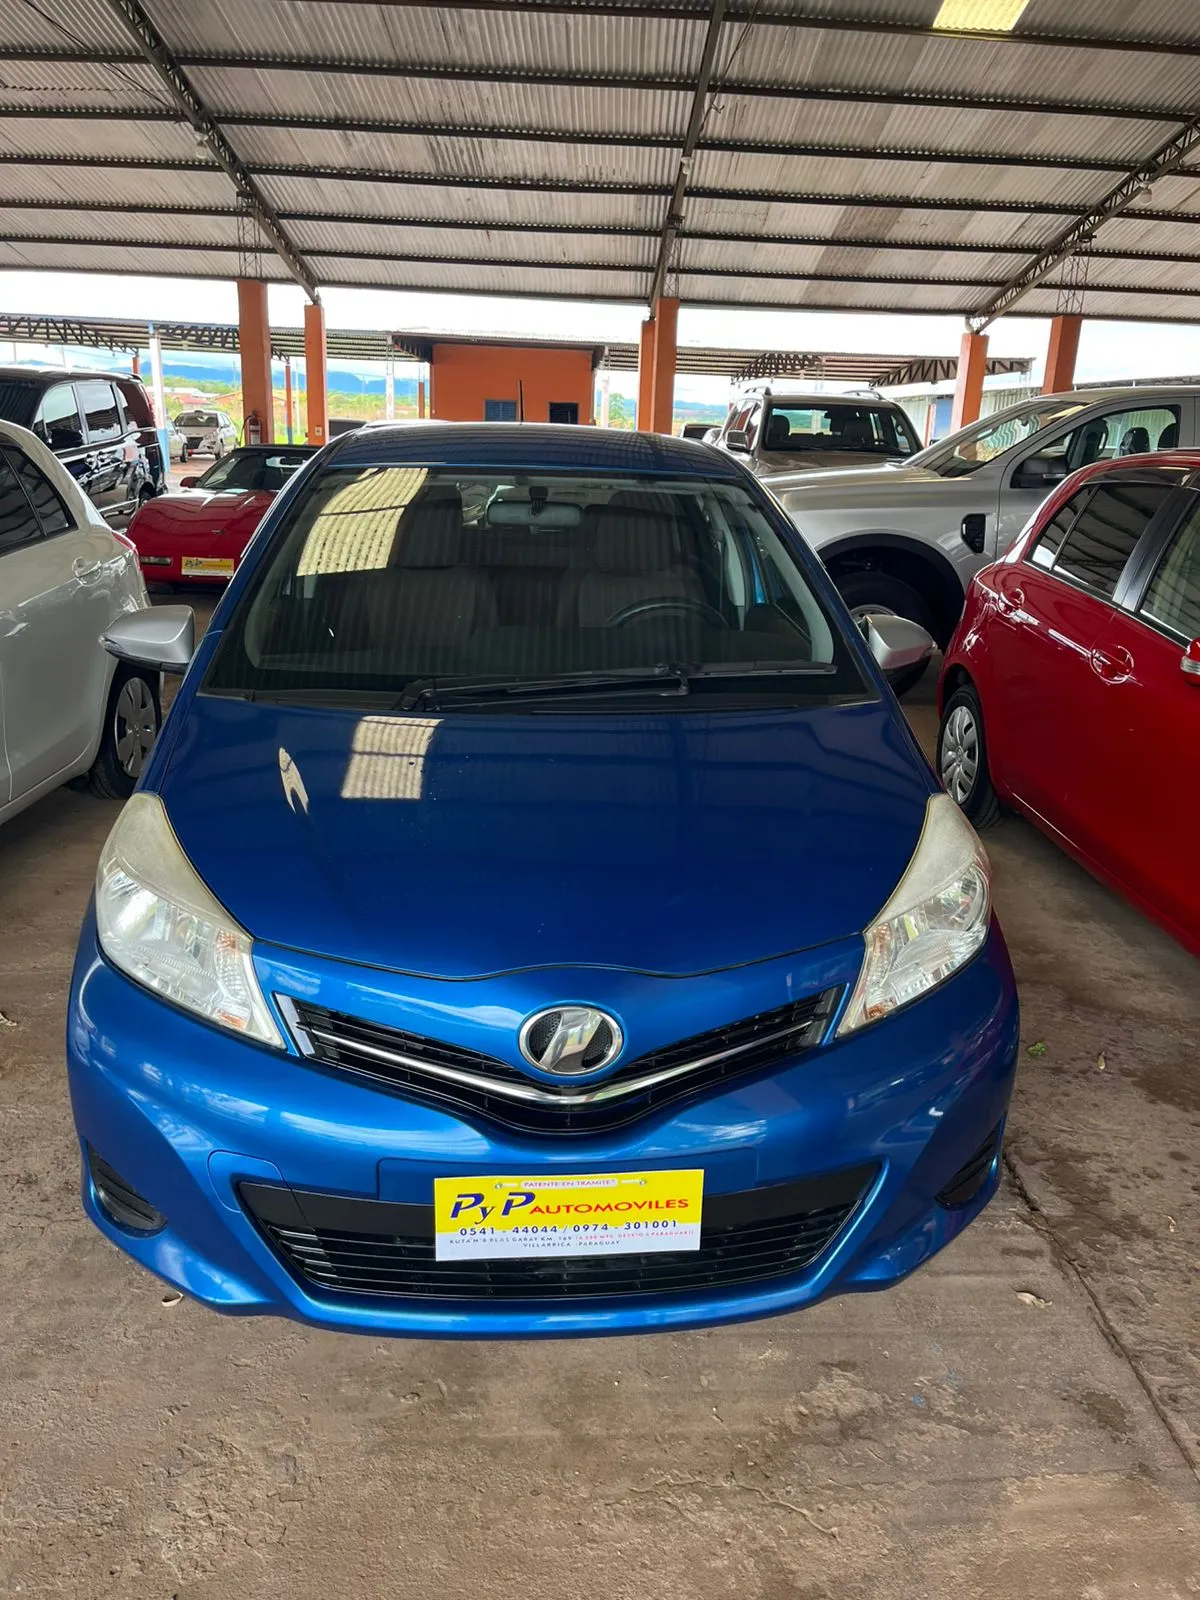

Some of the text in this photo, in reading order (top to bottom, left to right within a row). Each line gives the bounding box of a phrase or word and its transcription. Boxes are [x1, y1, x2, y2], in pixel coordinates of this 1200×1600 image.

[529, 1198, 689, 1216] AUTOMOVILES
[460, 1226, 495, 1237] 0541
[512, 1225, 558, 1235] 44044
[573, 1223, 609, 1233] 0974
[624, 1219, 678, 1231] 301001
